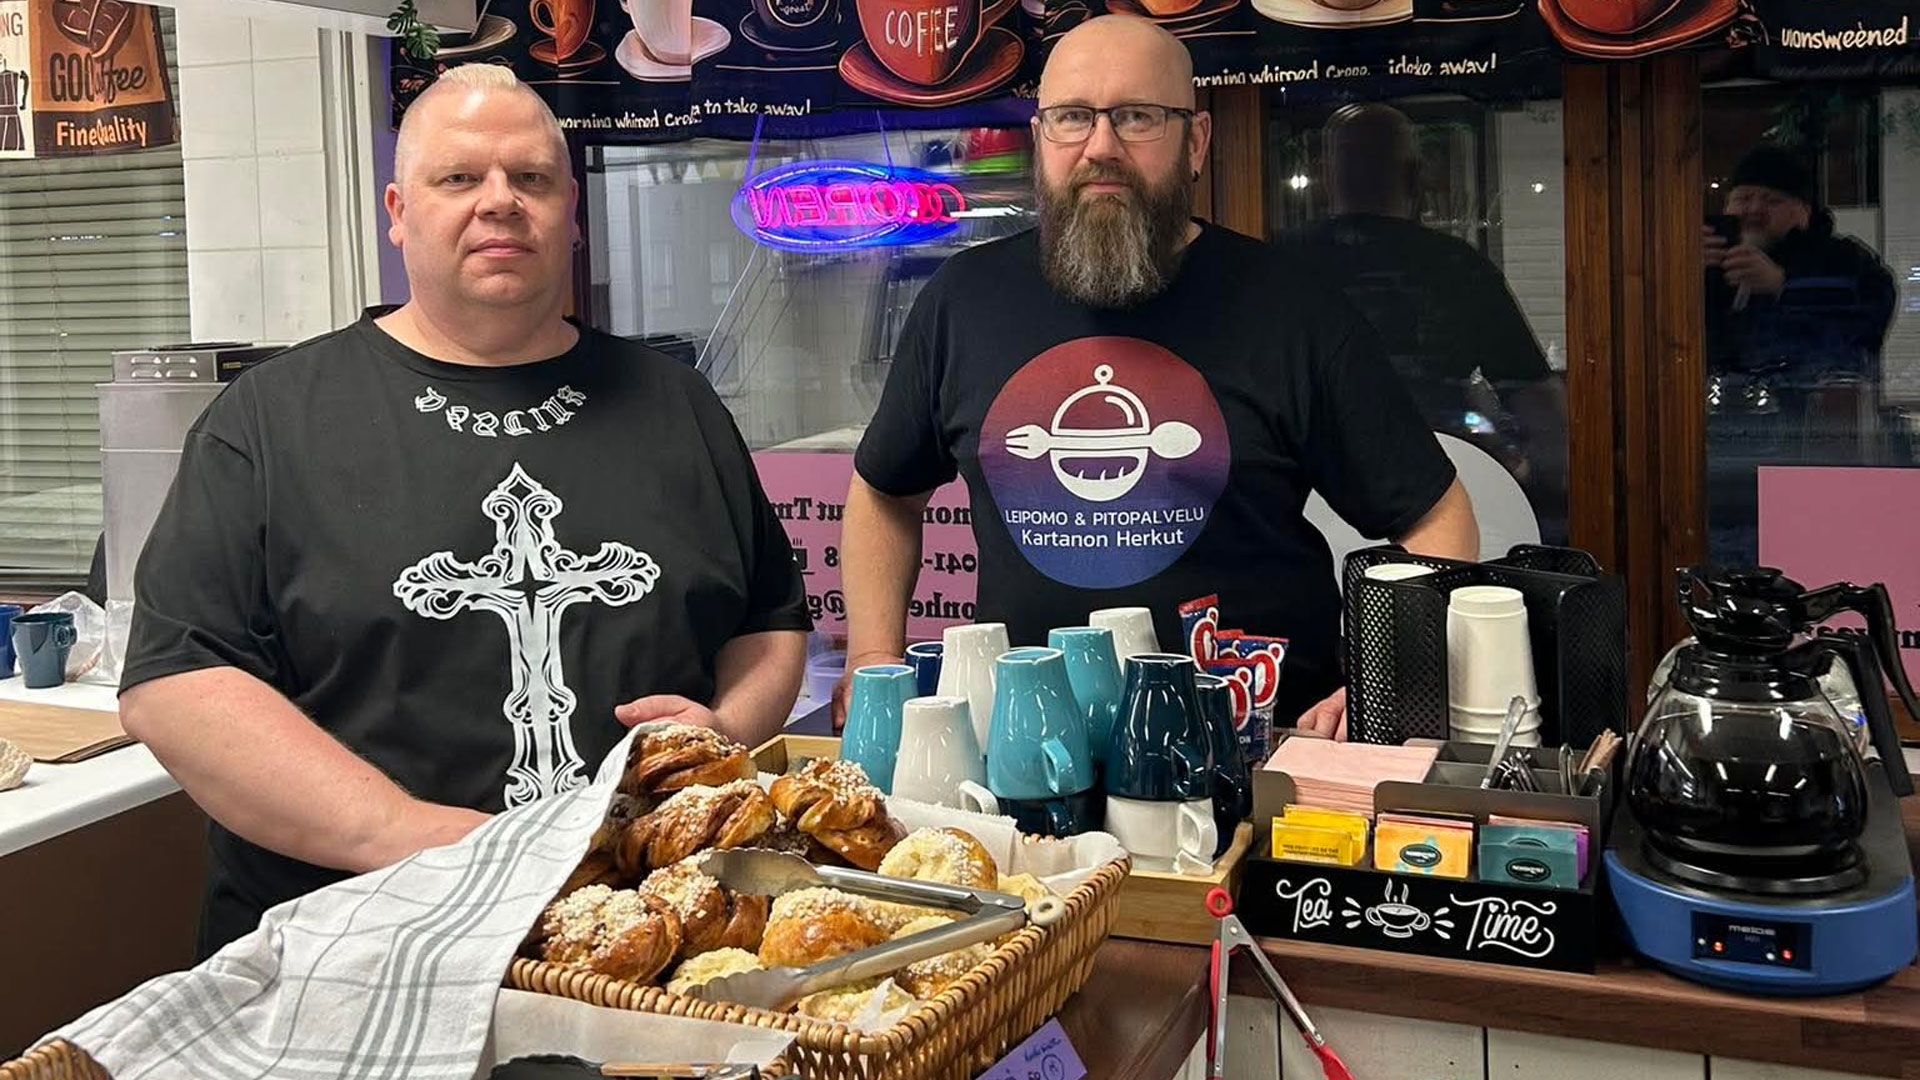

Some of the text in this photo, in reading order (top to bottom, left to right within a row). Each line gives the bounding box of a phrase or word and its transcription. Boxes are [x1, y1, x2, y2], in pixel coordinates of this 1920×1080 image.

[1004, 507, 1205, 526] LEIPOMO & PITOPALVELU
[1021, 528, 1185, 548] Kartanon Herkut
[1276, 877, 1557, 958] Tea Time
